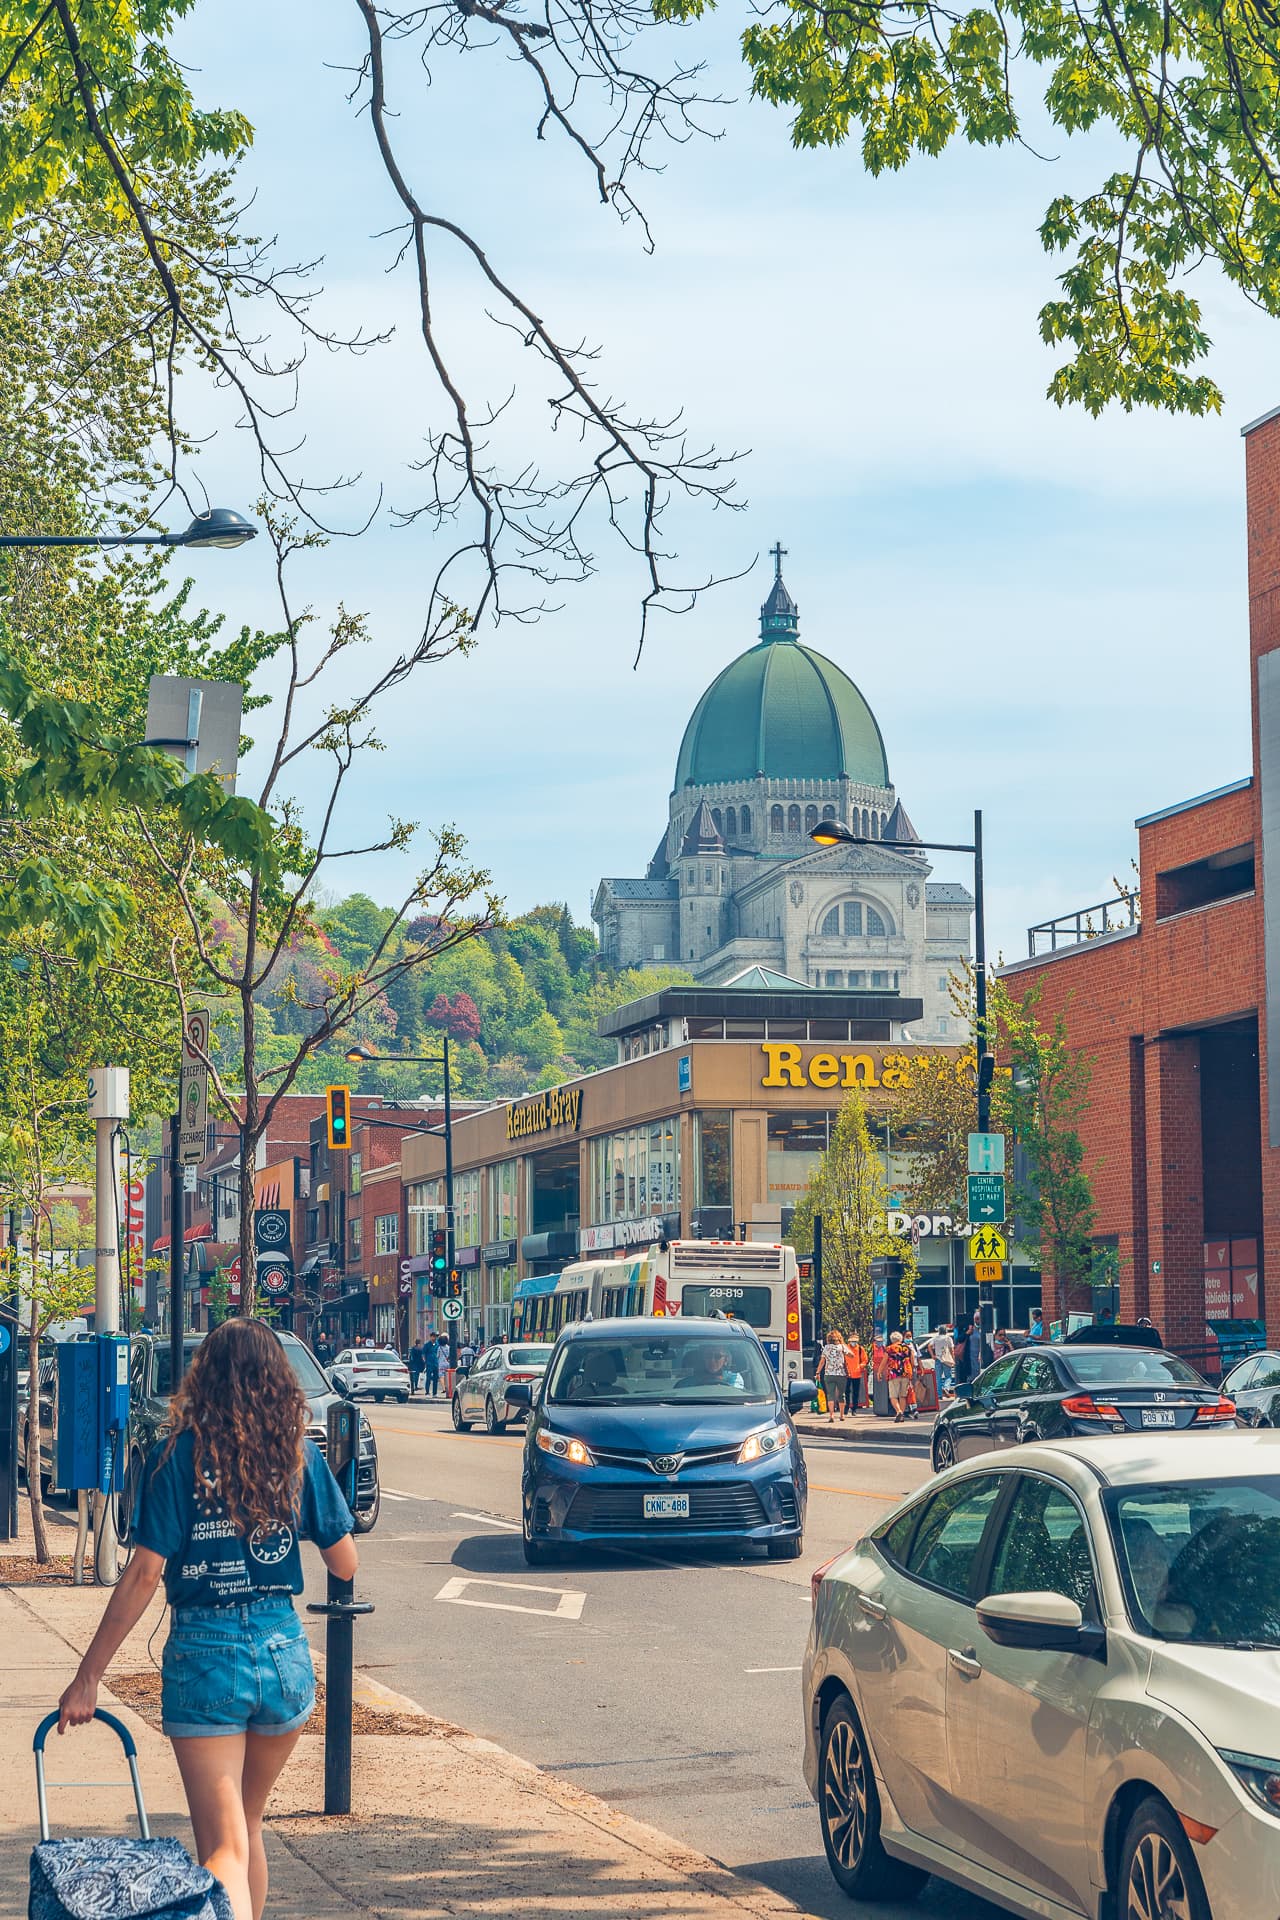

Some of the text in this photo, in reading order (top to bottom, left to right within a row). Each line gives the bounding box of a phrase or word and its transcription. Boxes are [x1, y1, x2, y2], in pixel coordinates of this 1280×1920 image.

[506, 1088, 581, 1139] Renaud-Bray
[180, 1131, 205, 1144] RECHARGE
[978, 1142, 995, 1163] H
[977, 1177, 995, 1185] CENTRE
[982, 1266, 996, 1276] FIN
[709, 1288, 744, 1298] 29-819
[645, 1500, 666, 1512] CKNC
[182, 1560, 208, 1576] saé
[210, 1579, 246, 1589] Université
